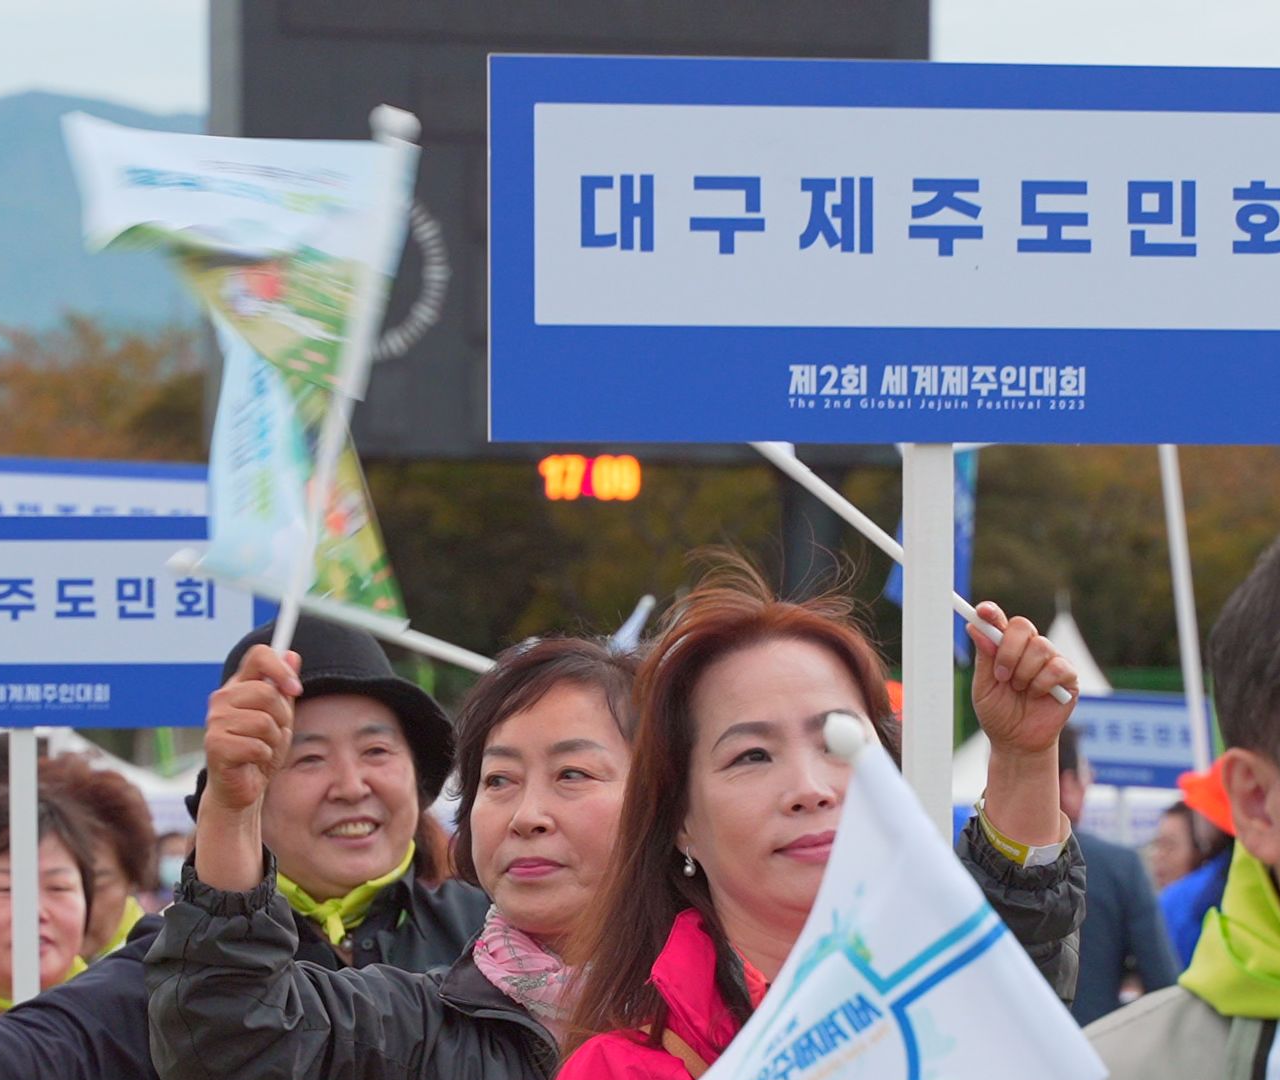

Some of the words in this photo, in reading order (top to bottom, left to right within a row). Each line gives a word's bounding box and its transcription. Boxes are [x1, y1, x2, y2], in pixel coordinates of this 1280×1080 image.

[788, 364, 868, 396] 제2회
[880, 364, 1086, 397] 세계제주인대회
[788, 398, 816, 410] The
[824, 398, 852, 410] 2nd
[859, 398, 912, 410] Global
[976, 398, 1042, 411] Festival
[1049, 399, 1086, 411] 2023
